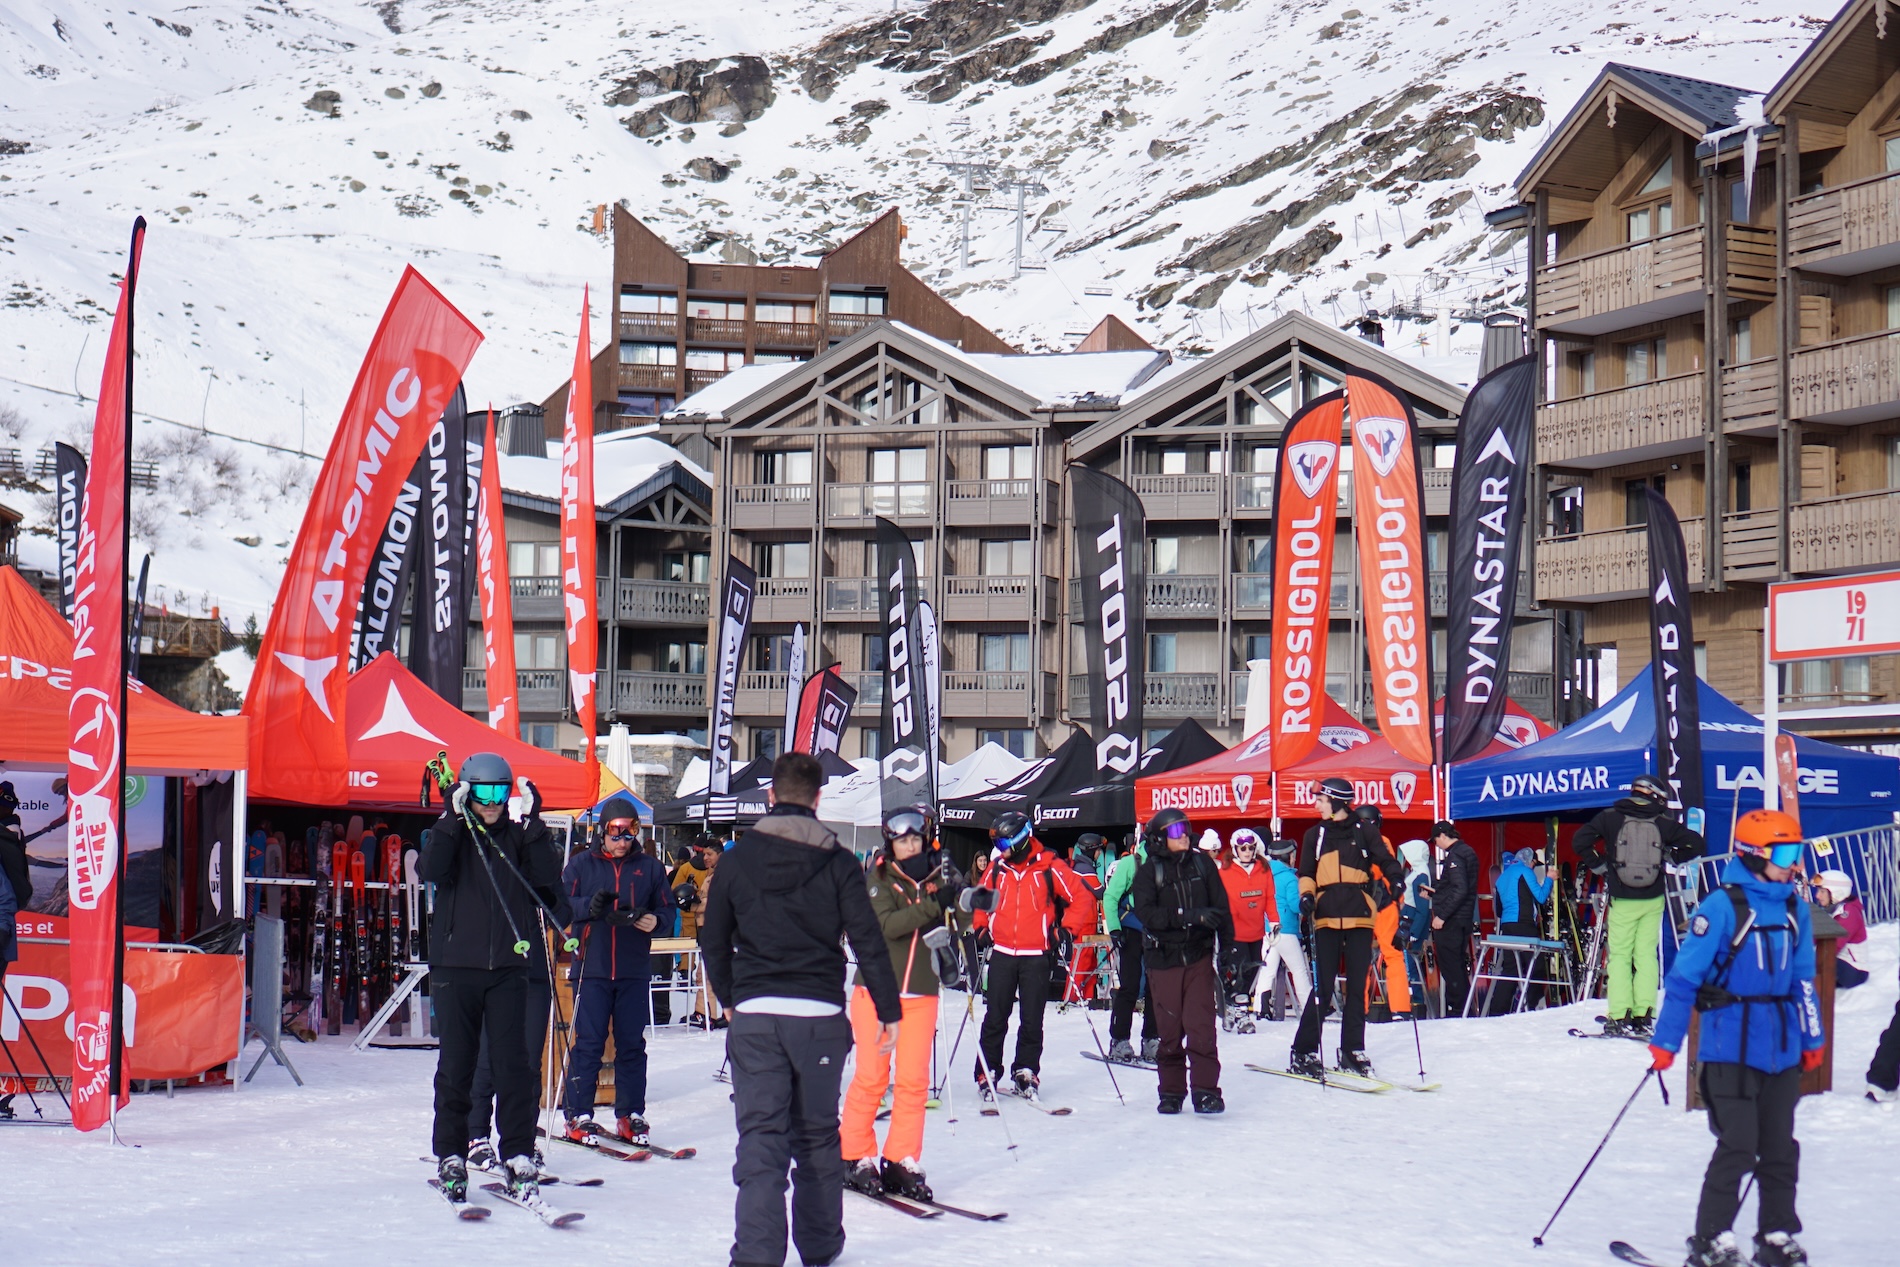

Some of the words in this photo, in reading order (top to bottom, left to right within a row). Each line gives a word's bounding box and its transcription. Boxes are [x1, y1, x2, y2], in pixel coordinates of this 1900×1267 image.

[312, 367, 422, 633] ATOMIC
[1465, 475, 1510, 704] DYNASTAR
[1846, 589, 1866, 615] 19
[1281, 506, 1322, 733] ROSSIGNOL
[1846, 616, 1865, 641] 71
[1698, 721, 1765, 735] ANGE
[1294, 780, 1390, 805] RONOL
[1502, 766, 1609, 798] DYNASTAR
[1716, 765, 1839, 794] LAGE
[1151, 784, 1231, 811] ROSSIGNOL
[945, 809, 975, 820] SCOTT
[1042, 808, 1079, 819] SCOTT
[37, 922, 54, 934] et
